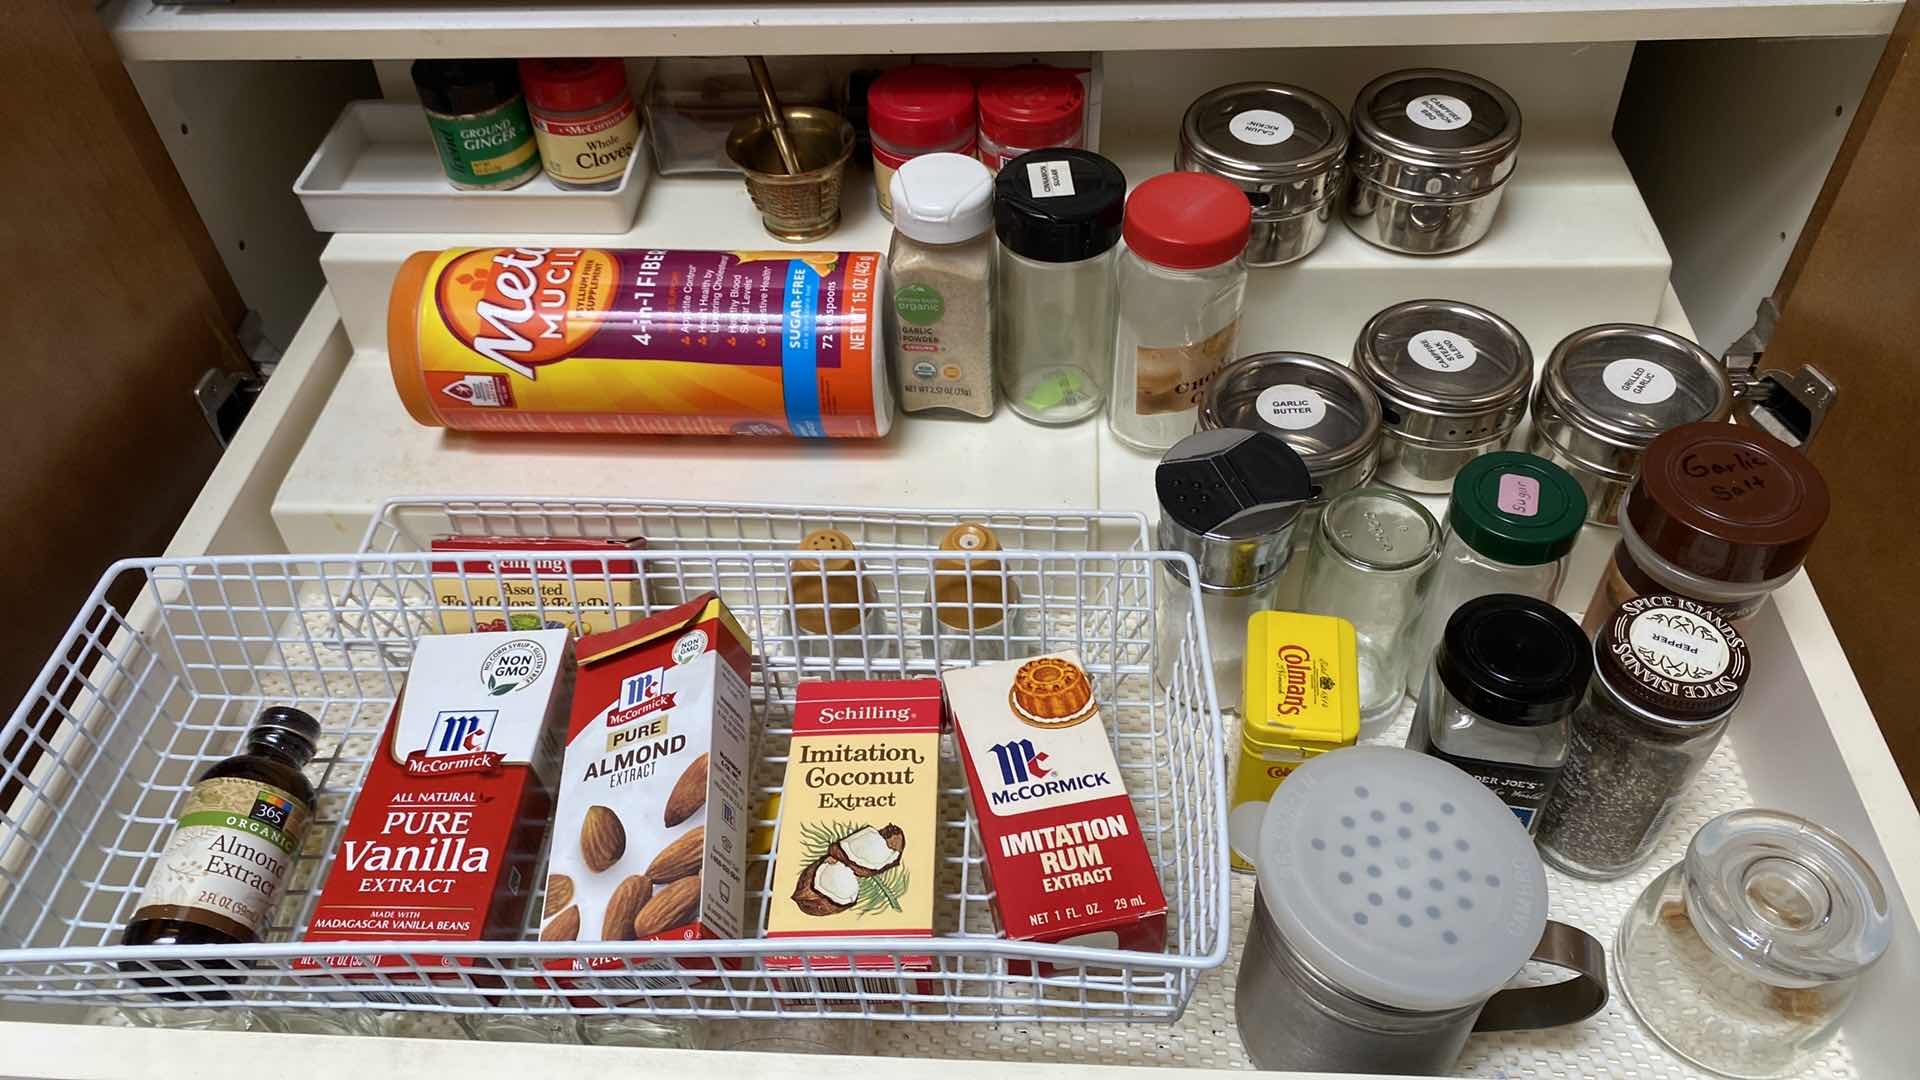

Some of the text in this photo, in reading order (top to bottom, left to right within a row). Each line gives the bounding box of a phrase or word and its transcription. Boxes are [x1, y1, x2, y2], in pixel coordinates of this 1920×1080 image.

[459, 119, 511, 139] GROUND
[464, 127, 517, 151] GINGER
[1244, 125, 1276, 136] CAJUN
[586, 134, 619, 151] Whole
[576, 142, 633, 169] Cloves
[1050, 168, 1061, 187] SUGAR
[703, 269, 715, 279] by
[852, 277, 869, 291] OZ
[586, 262, 603, 312] SUPPLEMENT
[699, 279, 711, 307] Health
[730, 274, 742, 298] Blood
[788, 267, 806, 349] SUGAR-FREE
[851, 291, 867, 304] 15
[897, 303, 940, 313] organic
[902, 326, 933, 335] GARLIC
[902, 335, 940, 344] POWDER
[822, 335, 834, 349] 72
[1434, 341, 1456, 361] STEAK
[1420, 338, 1450, 369] CAMPFIRE
[1621, 367, 1646, 391] GRILLED
[1633, 373, 1656, 394] GARLIC
[1272, 400, 1310, 408] GARLIC
[1273, 407, 1313, 415] BUTTER
[1683, 451, 1768, 479] Garlic
[1511, 480, 1532, 513] Sugar
[1711, 476, 1766, 500] Salt
[503, 582, 563, 596] Assoted
[1621, 595, 1745, 650] SPICE ISLANDS
[679, 644, 700, 655] GMO
[680, 638, 700, 649] NON
[1651, 632, 1700, 655] PEPPER
[494, 665, 530, 677] GMO
[498, 655, 533, 666] NON
[1277, 644, 1311, 717] Colman's
[1612, 643, 1739, 700] SPICE ISLANDS
[609, 693, 669, 726] McCormick
[818, 706, 911, 724] Schilling
[612, 719, 662, 747] PURE
[408, 753, 492, 774] McCormick
[583, 734, 687, 783] ALMOND
[799, 743, 925, 765] Imitation
[609, 761, 657, 789] EXTRACT
[805, 766, 915, 788] Coconut
[1501, 778, 1534, 790] JOE'S
[391, 791, 477, 803] ALL NATURAL
[991, 772, 1112, 806] McCORMICK
[817, 791, 897, 812] Extract
[254, 803, 284, 824] 365
[380, 811, 473, 836] PURE
[226, 815, 294, 850] ORGANIC
[999, 815, 1129, 857] IMITATION
[343, 837, 491, 874] Vanilla
[1039, 843, 1105, 876] RUM
[358, 877, 456, 894] EXTRACT
[1042, 866, 1114, 894] EXTRACT
[198, 890, 207, 901] 2
[206, 893, 217, 905] FL
[218, 896, 233, 910] OZ
[1028, 894, 1147, 927] NET 1 FL. OZ. 29 mL
[314, 919, 471, 931] MADAGASCAR VANILLA BEANS
[371, 910, 421, 919] MADE WITH
